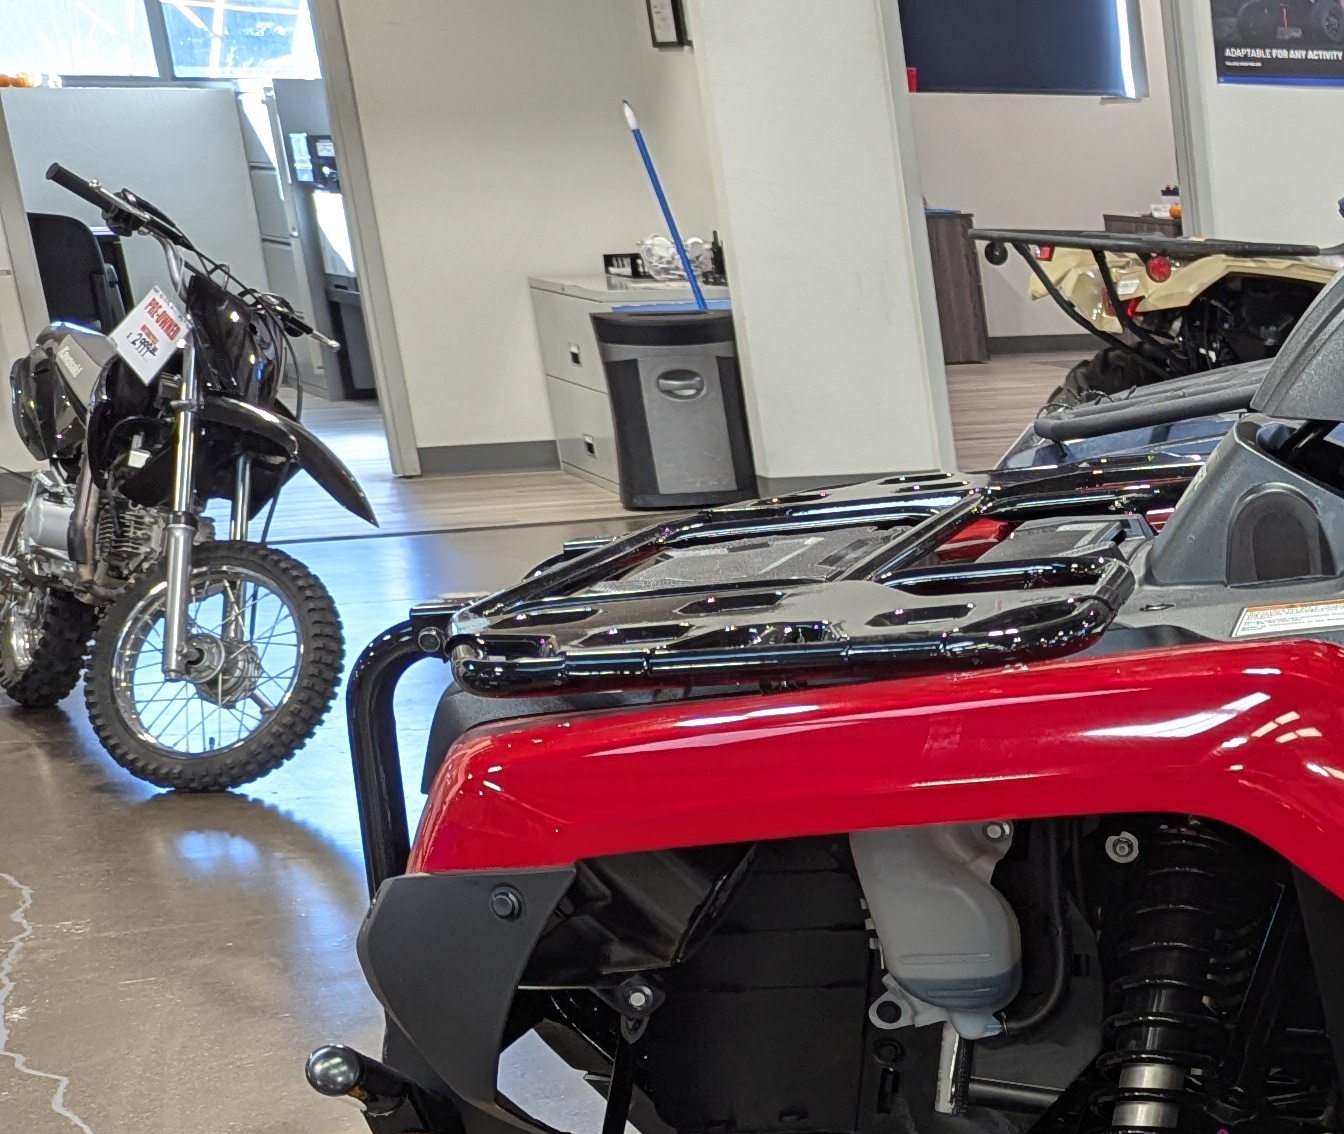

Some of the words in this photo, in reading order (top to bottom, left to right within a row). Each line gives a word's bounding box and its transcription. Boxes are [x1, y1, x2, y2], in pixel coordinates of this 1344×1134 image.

[1225, 48, 1271, 59] ADAPTABLE
[1272, 49, 1288, 59] FOR
[1289, 50, 1306, 60] ANY
[1308, 50, 1343, 61] ACTIVITY
[144, 297, 181, 341] PRE-OWNED
